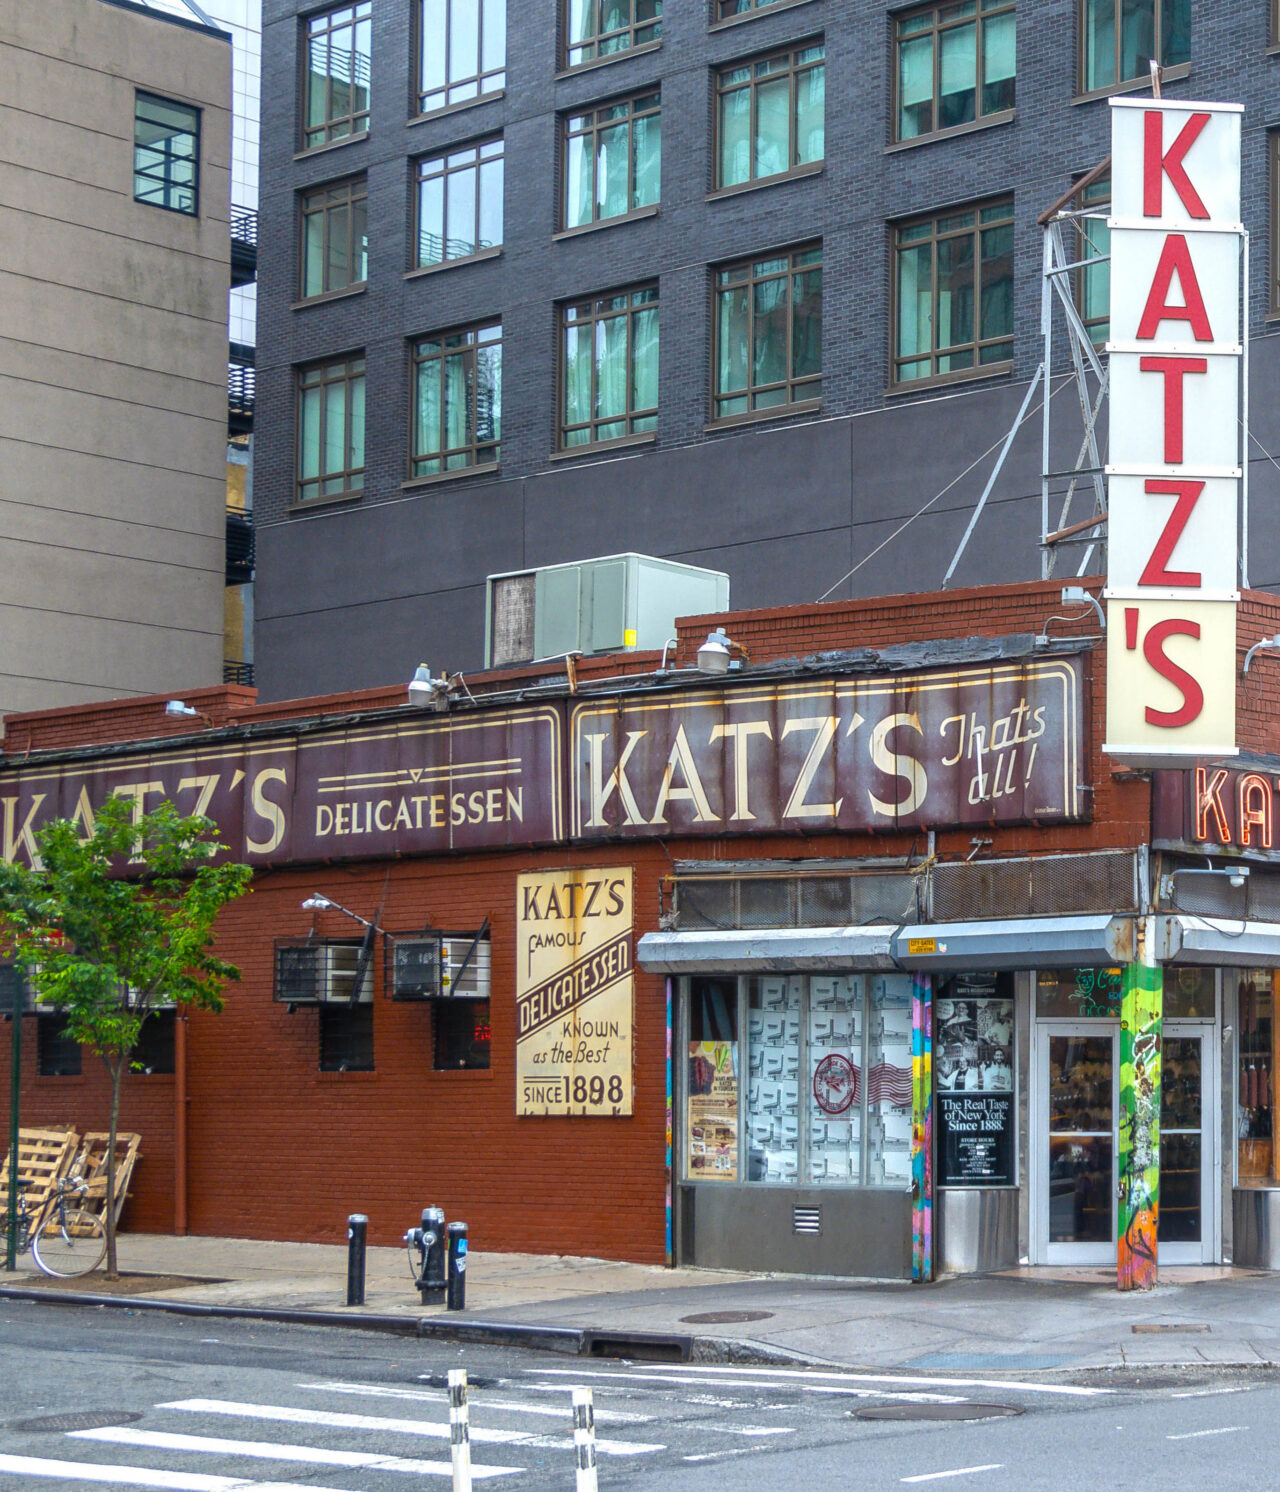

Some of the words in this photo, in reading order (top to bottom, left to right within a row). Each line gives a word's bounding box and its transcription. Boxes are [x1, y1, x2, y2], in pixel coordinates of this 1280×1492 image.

[1124, 110, 1214, 727] KATZ'S
[940, 698, 1046, 766] That's
[584, 711, 928, 827] KATZ'S
[0, 768, 287, 872] KATZ'S
[315, 787, 523, 836] DELICATESSEN
[522, 878, 626, 921] KATZ'S
[519, 940, 629, 1033] DELICATESSEN
[563, 1021, 619, 1038] KNOWN
[533, 1052, 548, 1064] as
[551, 1041, 573, 1064] the
[574, 1041, 611, 1064] Best
[523, 1086, 562, 1103] SINCE
[941, 1098, 962, 1110] The
[964, 1098, 986, 1110] Real
[987, 1098, 1009, 1110] Taste
[945, 1109, 957, 1120] of
[957, 1109, 982, 1120] New
[984, 1109, 1007, 1120] York.
[948, 1119, 978, 1131] Since
